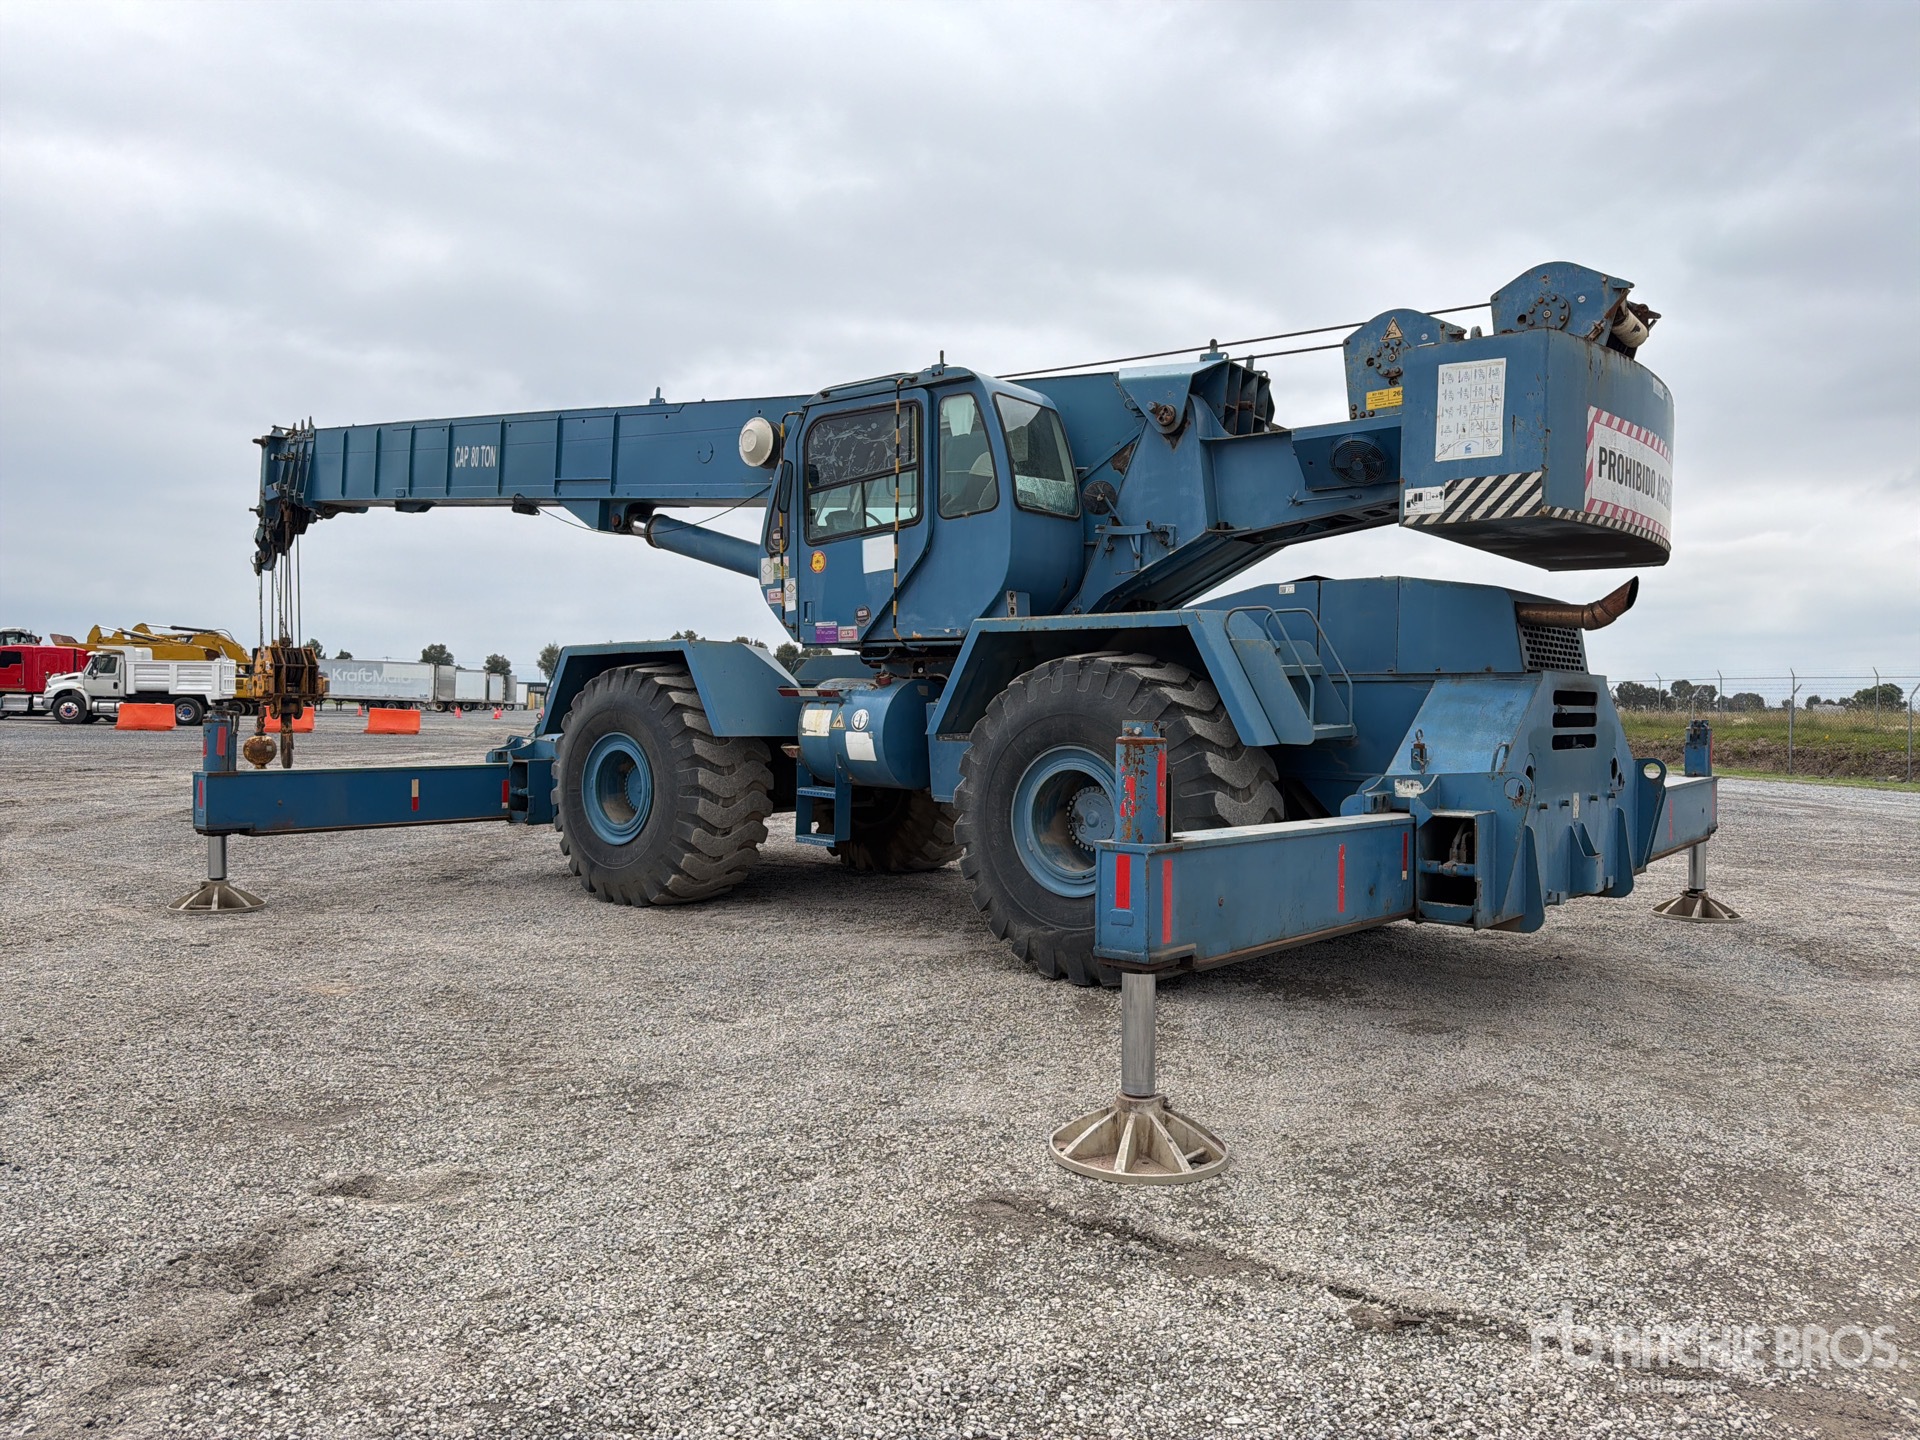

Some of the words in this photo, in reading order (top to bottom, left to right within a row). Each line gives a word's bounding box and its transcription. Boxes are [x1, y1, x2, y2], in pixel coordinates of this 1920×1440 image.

[455, 446, 469, 468] CAP
[471, 446, 479, 468] 80
[481, 445, 496, 468] TON
[1599, 446, 1656, 499] PROHIBIDO
